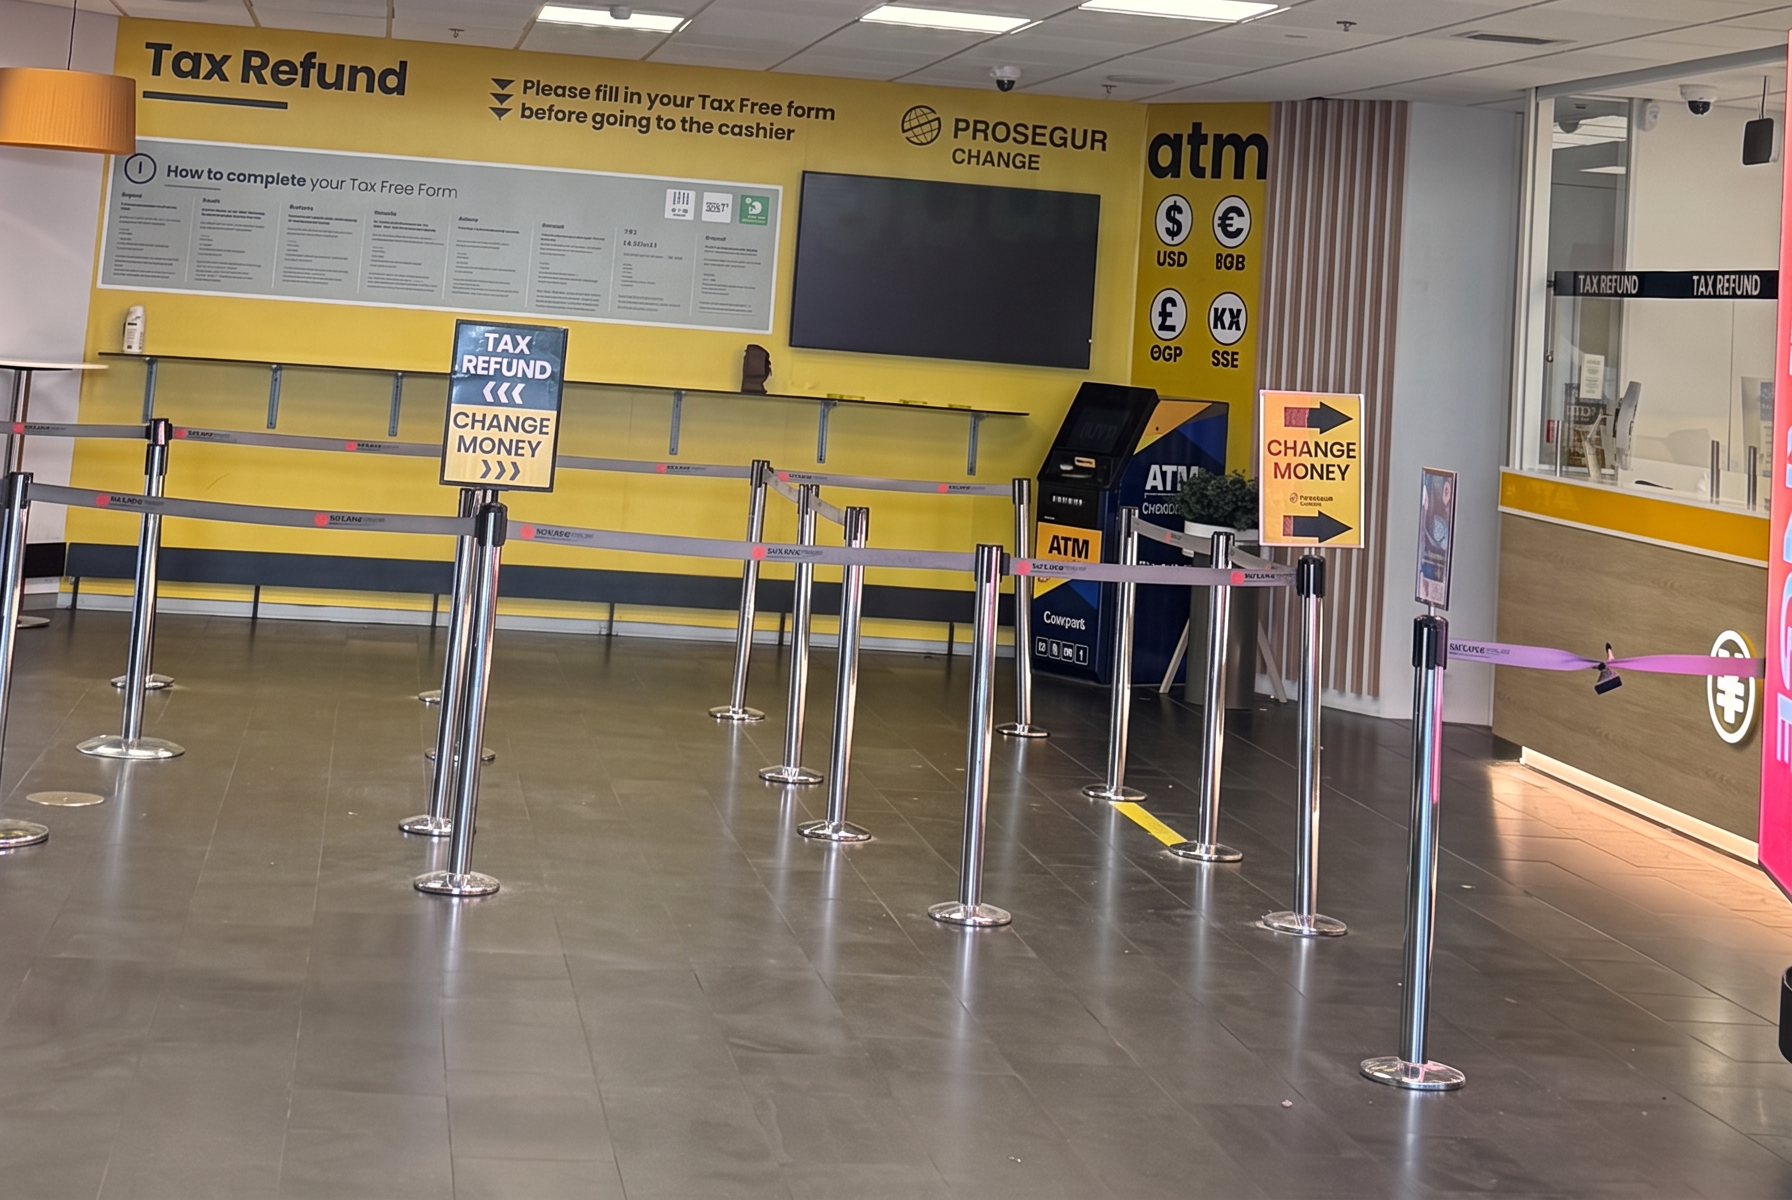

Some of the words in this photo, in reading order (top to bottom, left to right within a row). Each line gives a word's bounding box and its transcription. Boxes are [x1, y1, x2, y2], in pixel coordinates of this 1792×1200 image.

[145, 42, 232, 83] Tax
[241, 49, 408, 96] Refund
[522, 79, 591, 100] Please
[595, 84, 620, 103] fill
[623, 86, 642, 105] in
[646, 92, 695, 111] your
[698, 94, 735, 113] Tax
[739, 97, 783, 116] Free
[786, 100, 836, 121] form
[520, 102, 588, 124] before
[591, 109, 652, 135] going
[655, 114, 677, 131] to
[680, 116, 714, 134] the
[718, 121, 796, 141] cashier
[952, 117, 1108, 152] PROSEGUR
[951, 147, 1041, 171] CHANGE
[1147, 121, 1270, 180] atm
[166, 164, 205, 180] How
[206, 167, 224, 181] to
[226, 171, 307, 189] complete
[309, 177, 347, 193] your
[349, 177, 378, 193] Tax
[380, 179, 414, 196] Free
[417, 182, 459, 199] Form
[1156, 250, 1188, 268] USD
[1578, 274, 1600, 293] TAX
[1600, 274, 1640, 295] REFUND
[1692, 274, 1714, 296] TAX
[1716, 274, 1761, 296] REFUND
[484, 332, 533, 355] TAX
[461, 354, 553, 380] REFUND
[453, 411, 551, 436] CHANGE
[456, 435, 543, 458] MONEY
[1266, 439, 1357, 459] CHANGE
[1145, 464, 1199, 491] ATM
[1273, 462, 1351, 481] MONEY
[1048, 535, 1090, 560] ATM
